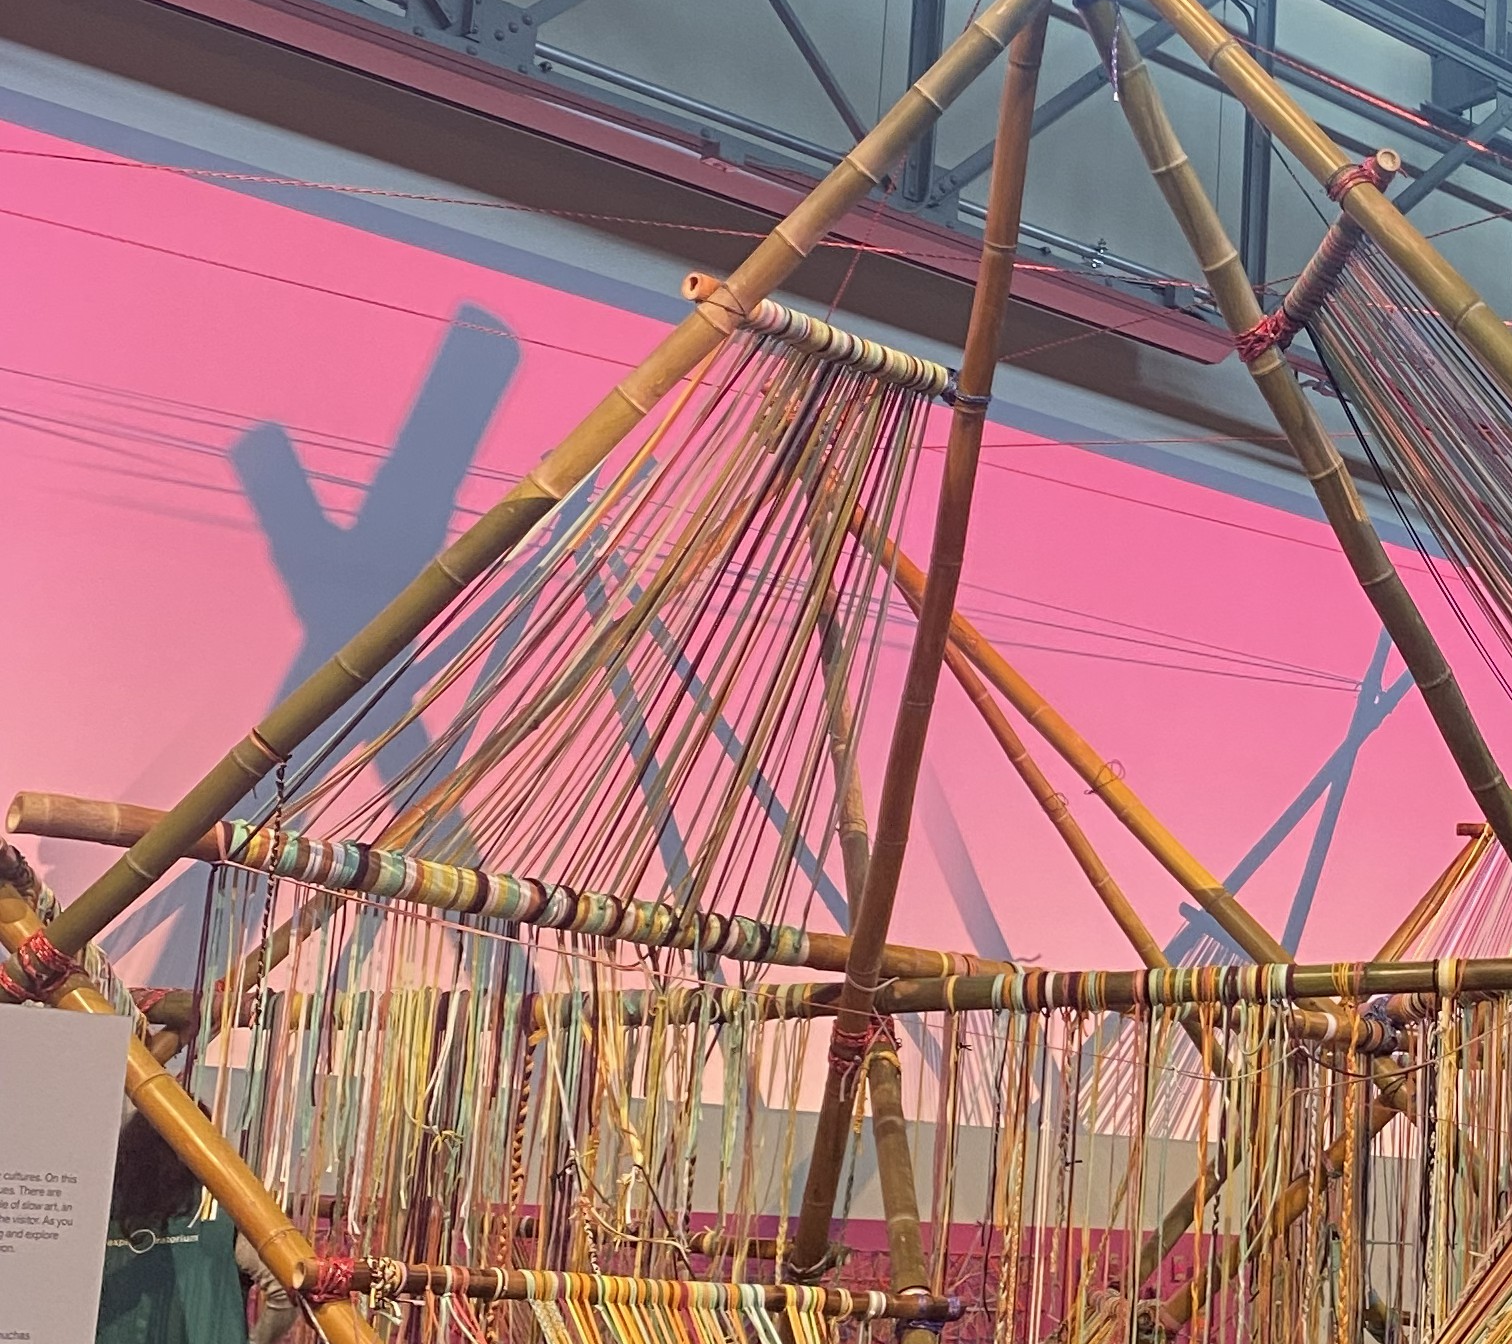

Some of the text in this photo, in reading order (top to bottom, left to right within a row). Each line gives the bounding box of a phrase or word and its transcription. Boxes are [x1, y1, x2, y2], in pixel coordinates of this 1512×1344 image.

[10, 1199, 21, 1210] of
[55, 1218, 74, 1228] you
[5, 1229, 24, 1239] and
